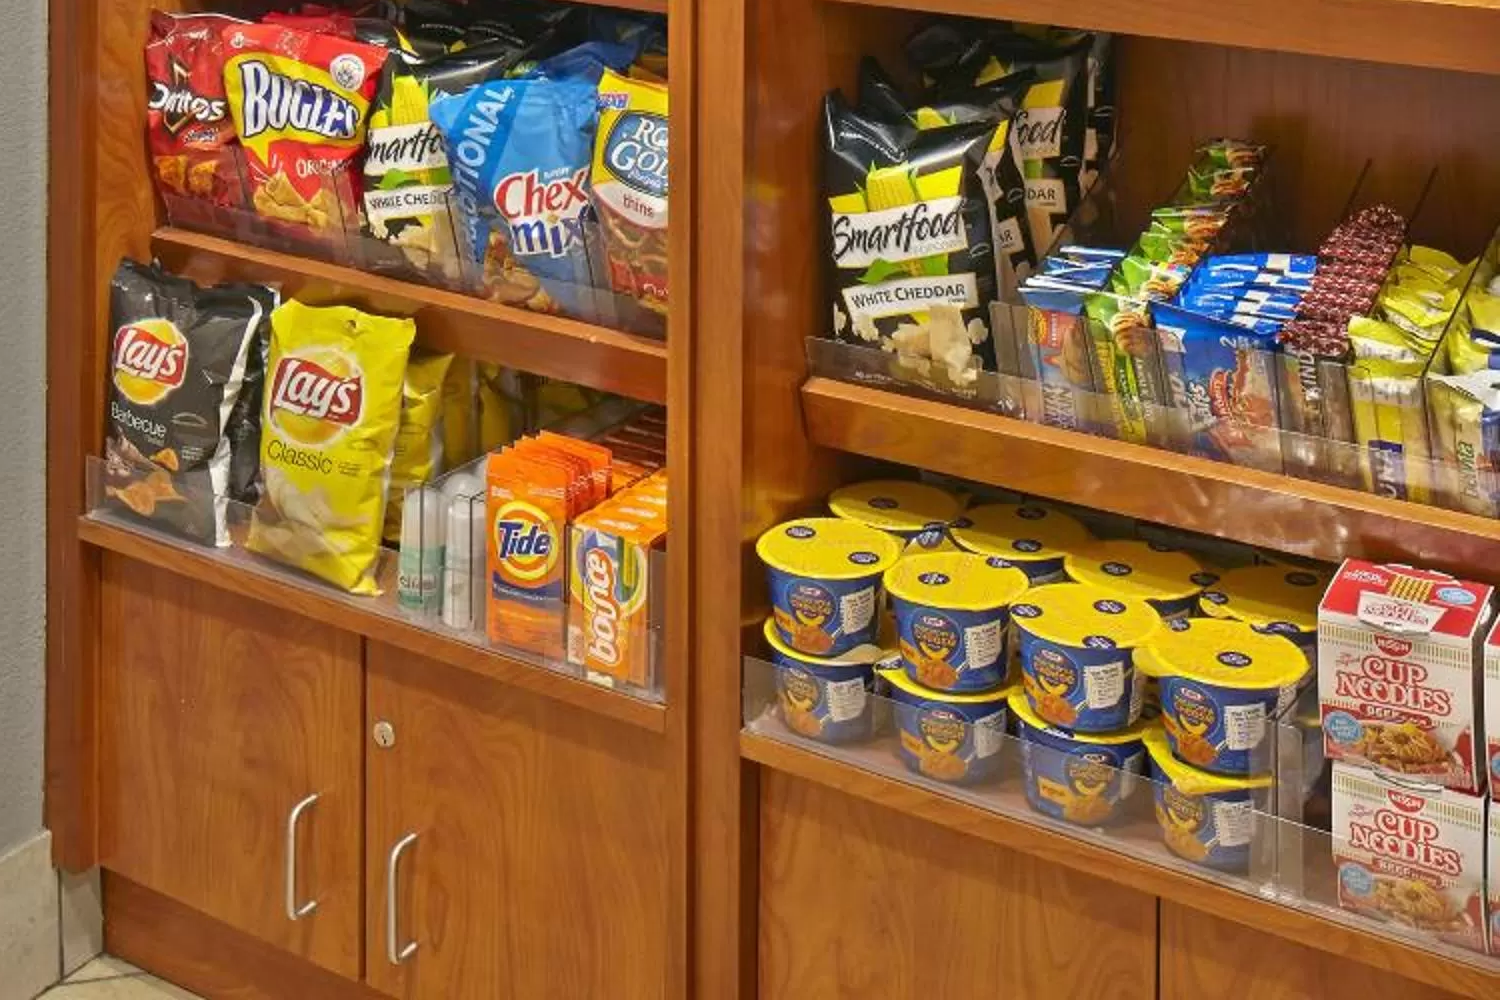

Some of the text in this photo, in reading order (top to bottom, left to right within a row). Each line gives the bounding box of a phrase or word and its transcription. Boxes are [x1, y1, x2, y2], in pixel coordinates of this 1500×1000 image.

[494, 166, 590, 220] Chex
[832, 200, 967, 260] Smartfood
[851, 283, 966, 309] WHITE CHEDDAR
[115, 329, 185, 380] Lay's
[1298, 351, 1322, 401] KIND
[273, 359, 358, 418] Lay's
[111, 401, 167, 437] Barbecue
[266, 439, 333, 474] Classic
[498, 518, 553, 559] Tide
[1335, 669, 1452, 717] NOODLES
[1361, 655, 1429, 688] CUP
[1350, 821, 1463, 877] NOODLES
[1373, 808, 1439, 842] CUP
